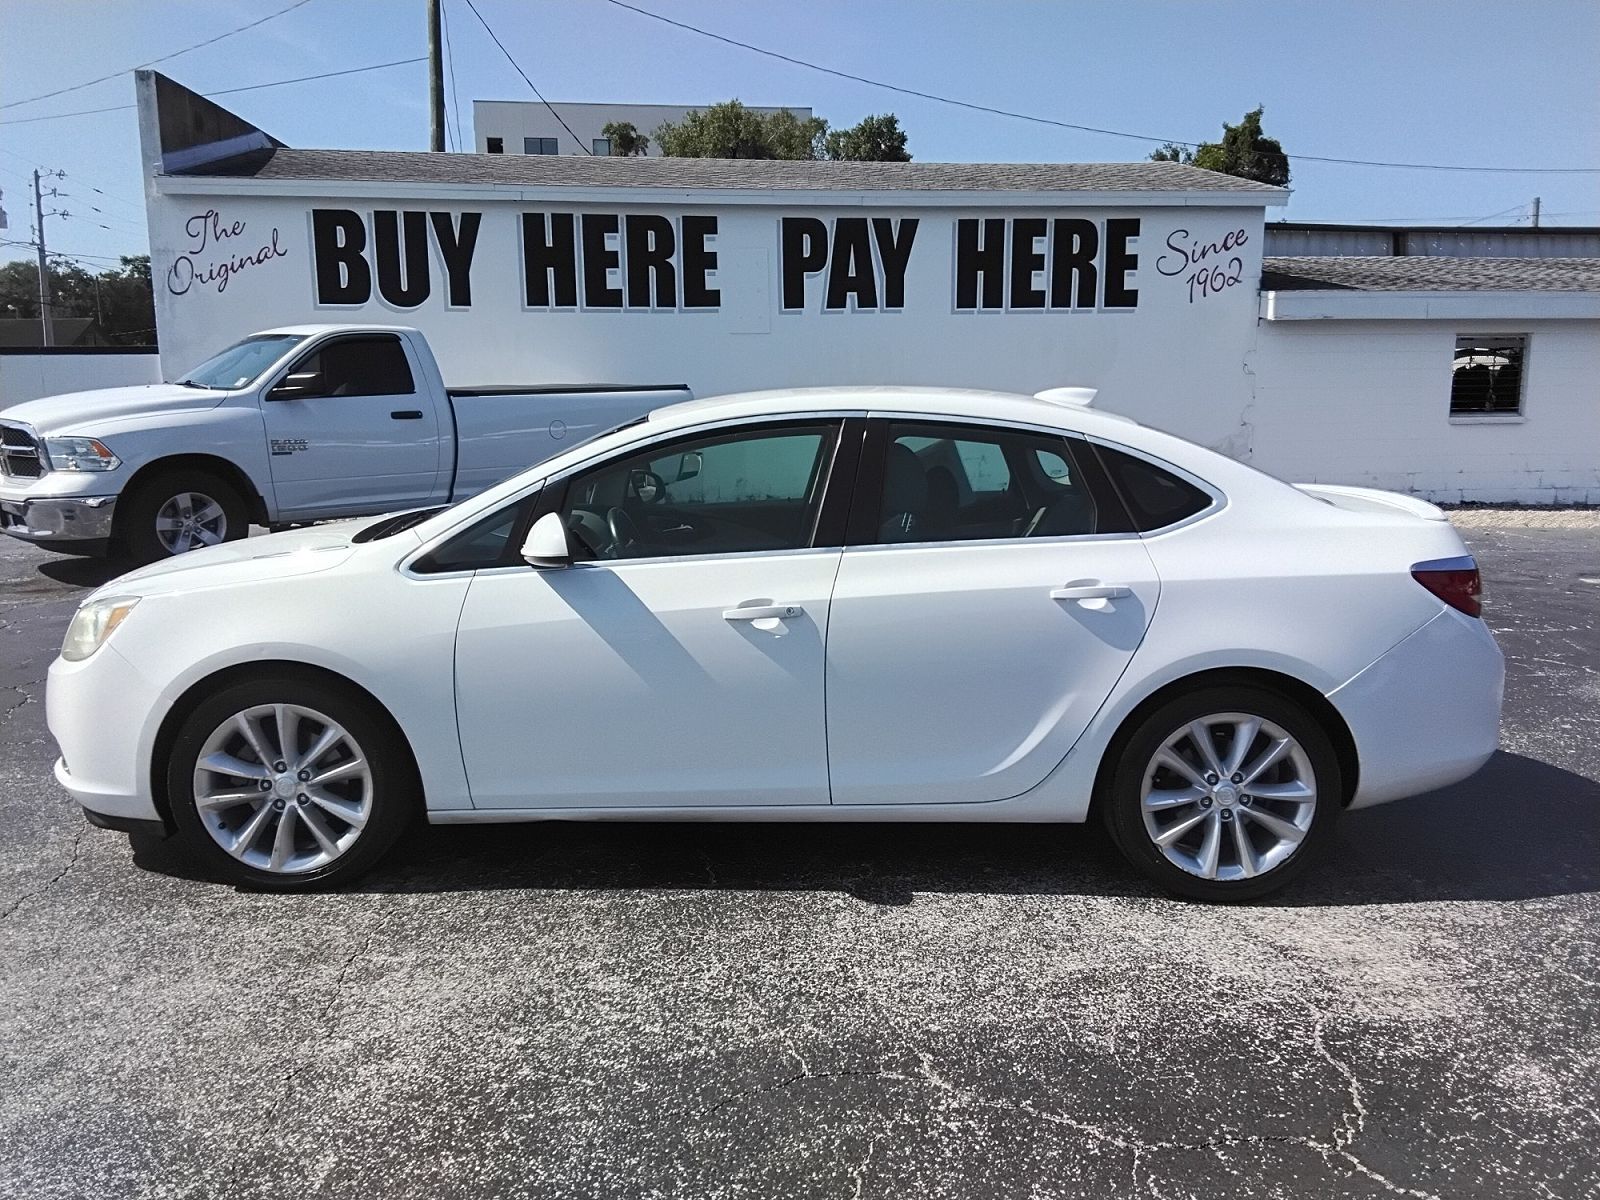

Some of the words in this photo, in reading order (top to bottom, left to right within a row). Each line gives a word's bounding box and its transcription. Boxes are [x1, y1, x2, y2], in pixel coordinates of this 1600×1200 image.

[184, 209, 246, 255] The
[1155, 225, 1249, 276] Since
[166, 228, 288, 296] Original
[310, 208, 482, 309] BUY
[521, 212, 721, 310] HERE
[781, 216, 920, 311] PAY
[955, 217, 1141, 311] HERE
[1186, 256, 1243, 304] 1962
